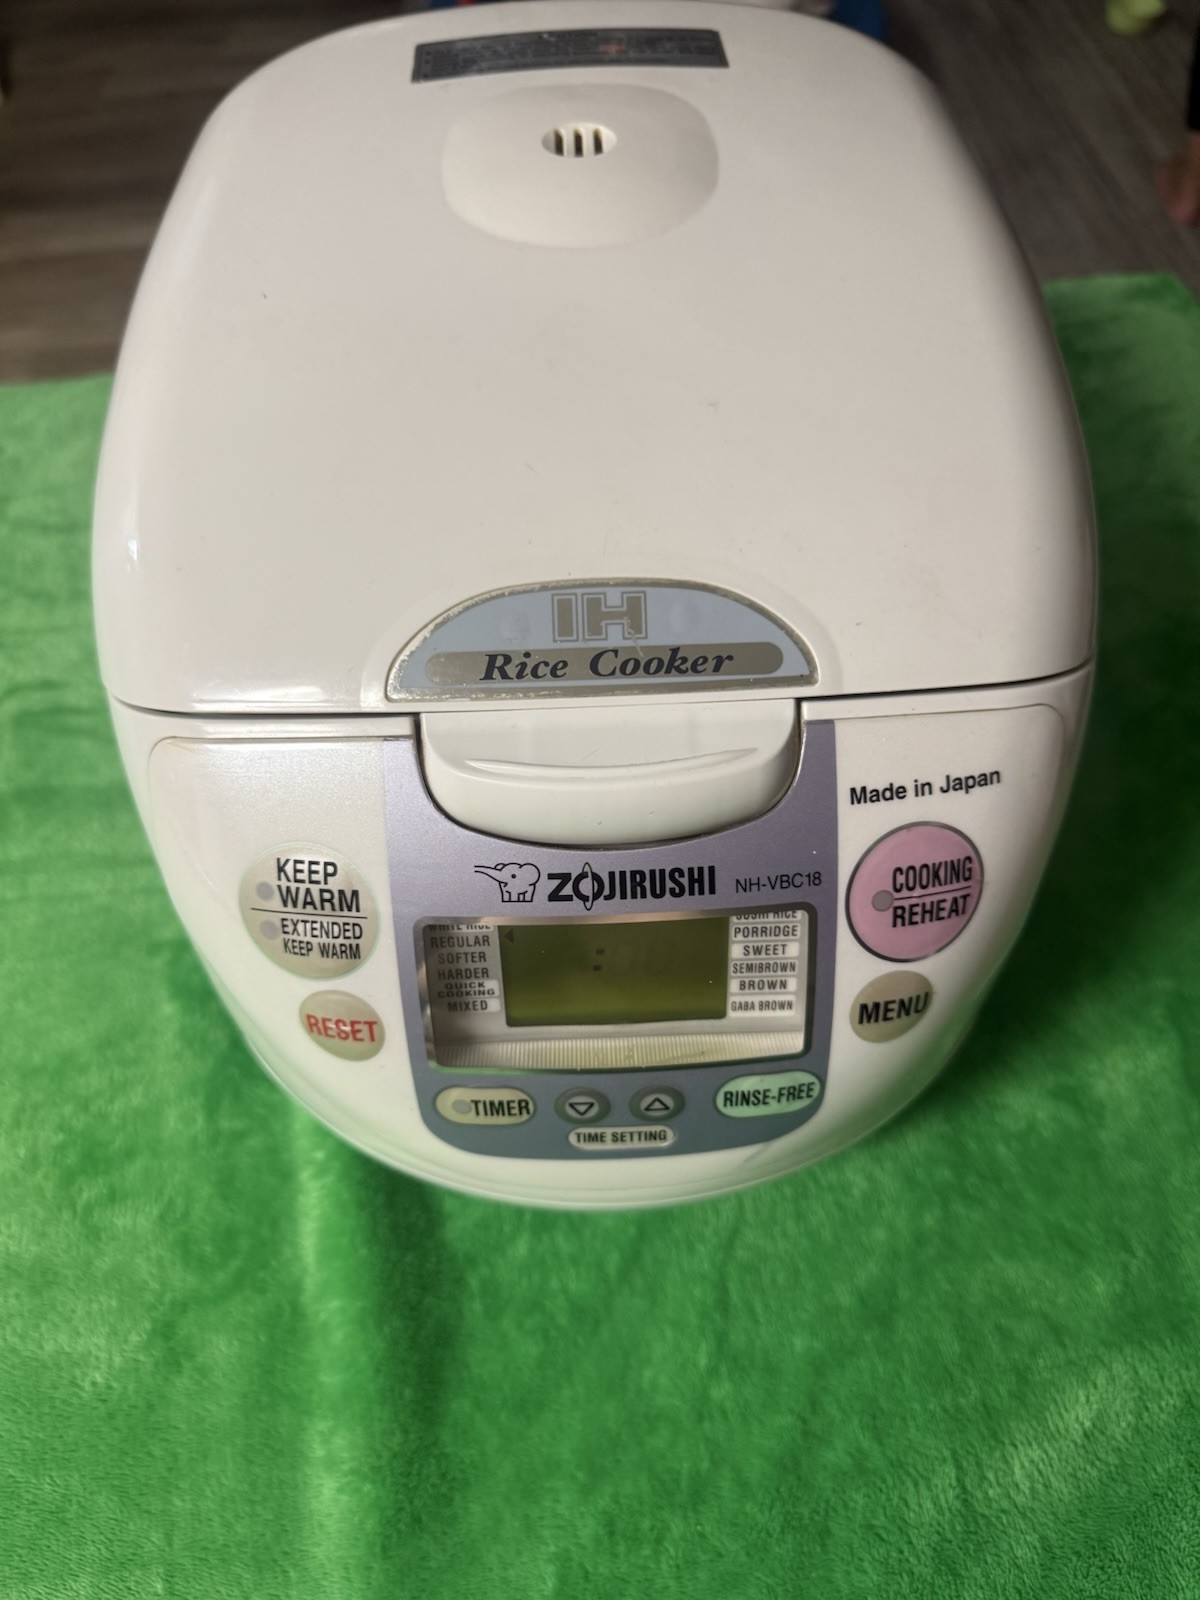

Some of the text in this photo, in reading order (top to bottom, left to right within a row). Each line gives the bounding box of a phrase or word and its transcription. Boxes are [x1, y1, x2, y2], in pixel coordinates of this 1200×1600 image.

[551, 590, 648, 643] IH
[479, 646, 735, 682] Rice Cooker
[850, 770, 1001, 805] Made in Japan
[276, 857, 338, 886] KEEP
[892, 856, 972, 893] COOKING
[547, 862, 822, 911] ZOJIRUSHI NH-VBC18
[277, 885, 360, 913] WARM
[892, 893, 971, 928] REHEAT
[281, 918, 363, 940] EXTENDED
[734, 925, 798, 938] PORRIDGE
[284, 938, 361, 960] KEEP WARM
[430, 935, 490, 948] REGULAR
[743, 944, 787, 956] SWEET
[438, 952, 486, 964] SOFTER
[732, 961, 796, 974] SEMIBROWN
[438, 967, 489, 980] HARDER
[438, 989, 495, 998] COOKING
[445, 981, 486, 990] QUICK
[739, 979, 787, 991] BROWN
[447, 1000, 488, 1012] MIXED
[731, 1000, 793, 1011] GABA BROWN
[858, 991, 929, 1024] MENU
[306, 1013, 378, 1042] RESET
[722, 1081, 815, 1107] RINSE-FREE
[471, 1098, 530, 1117] TIMER
[574, 1130, 667, 1143] TIME SETTING
